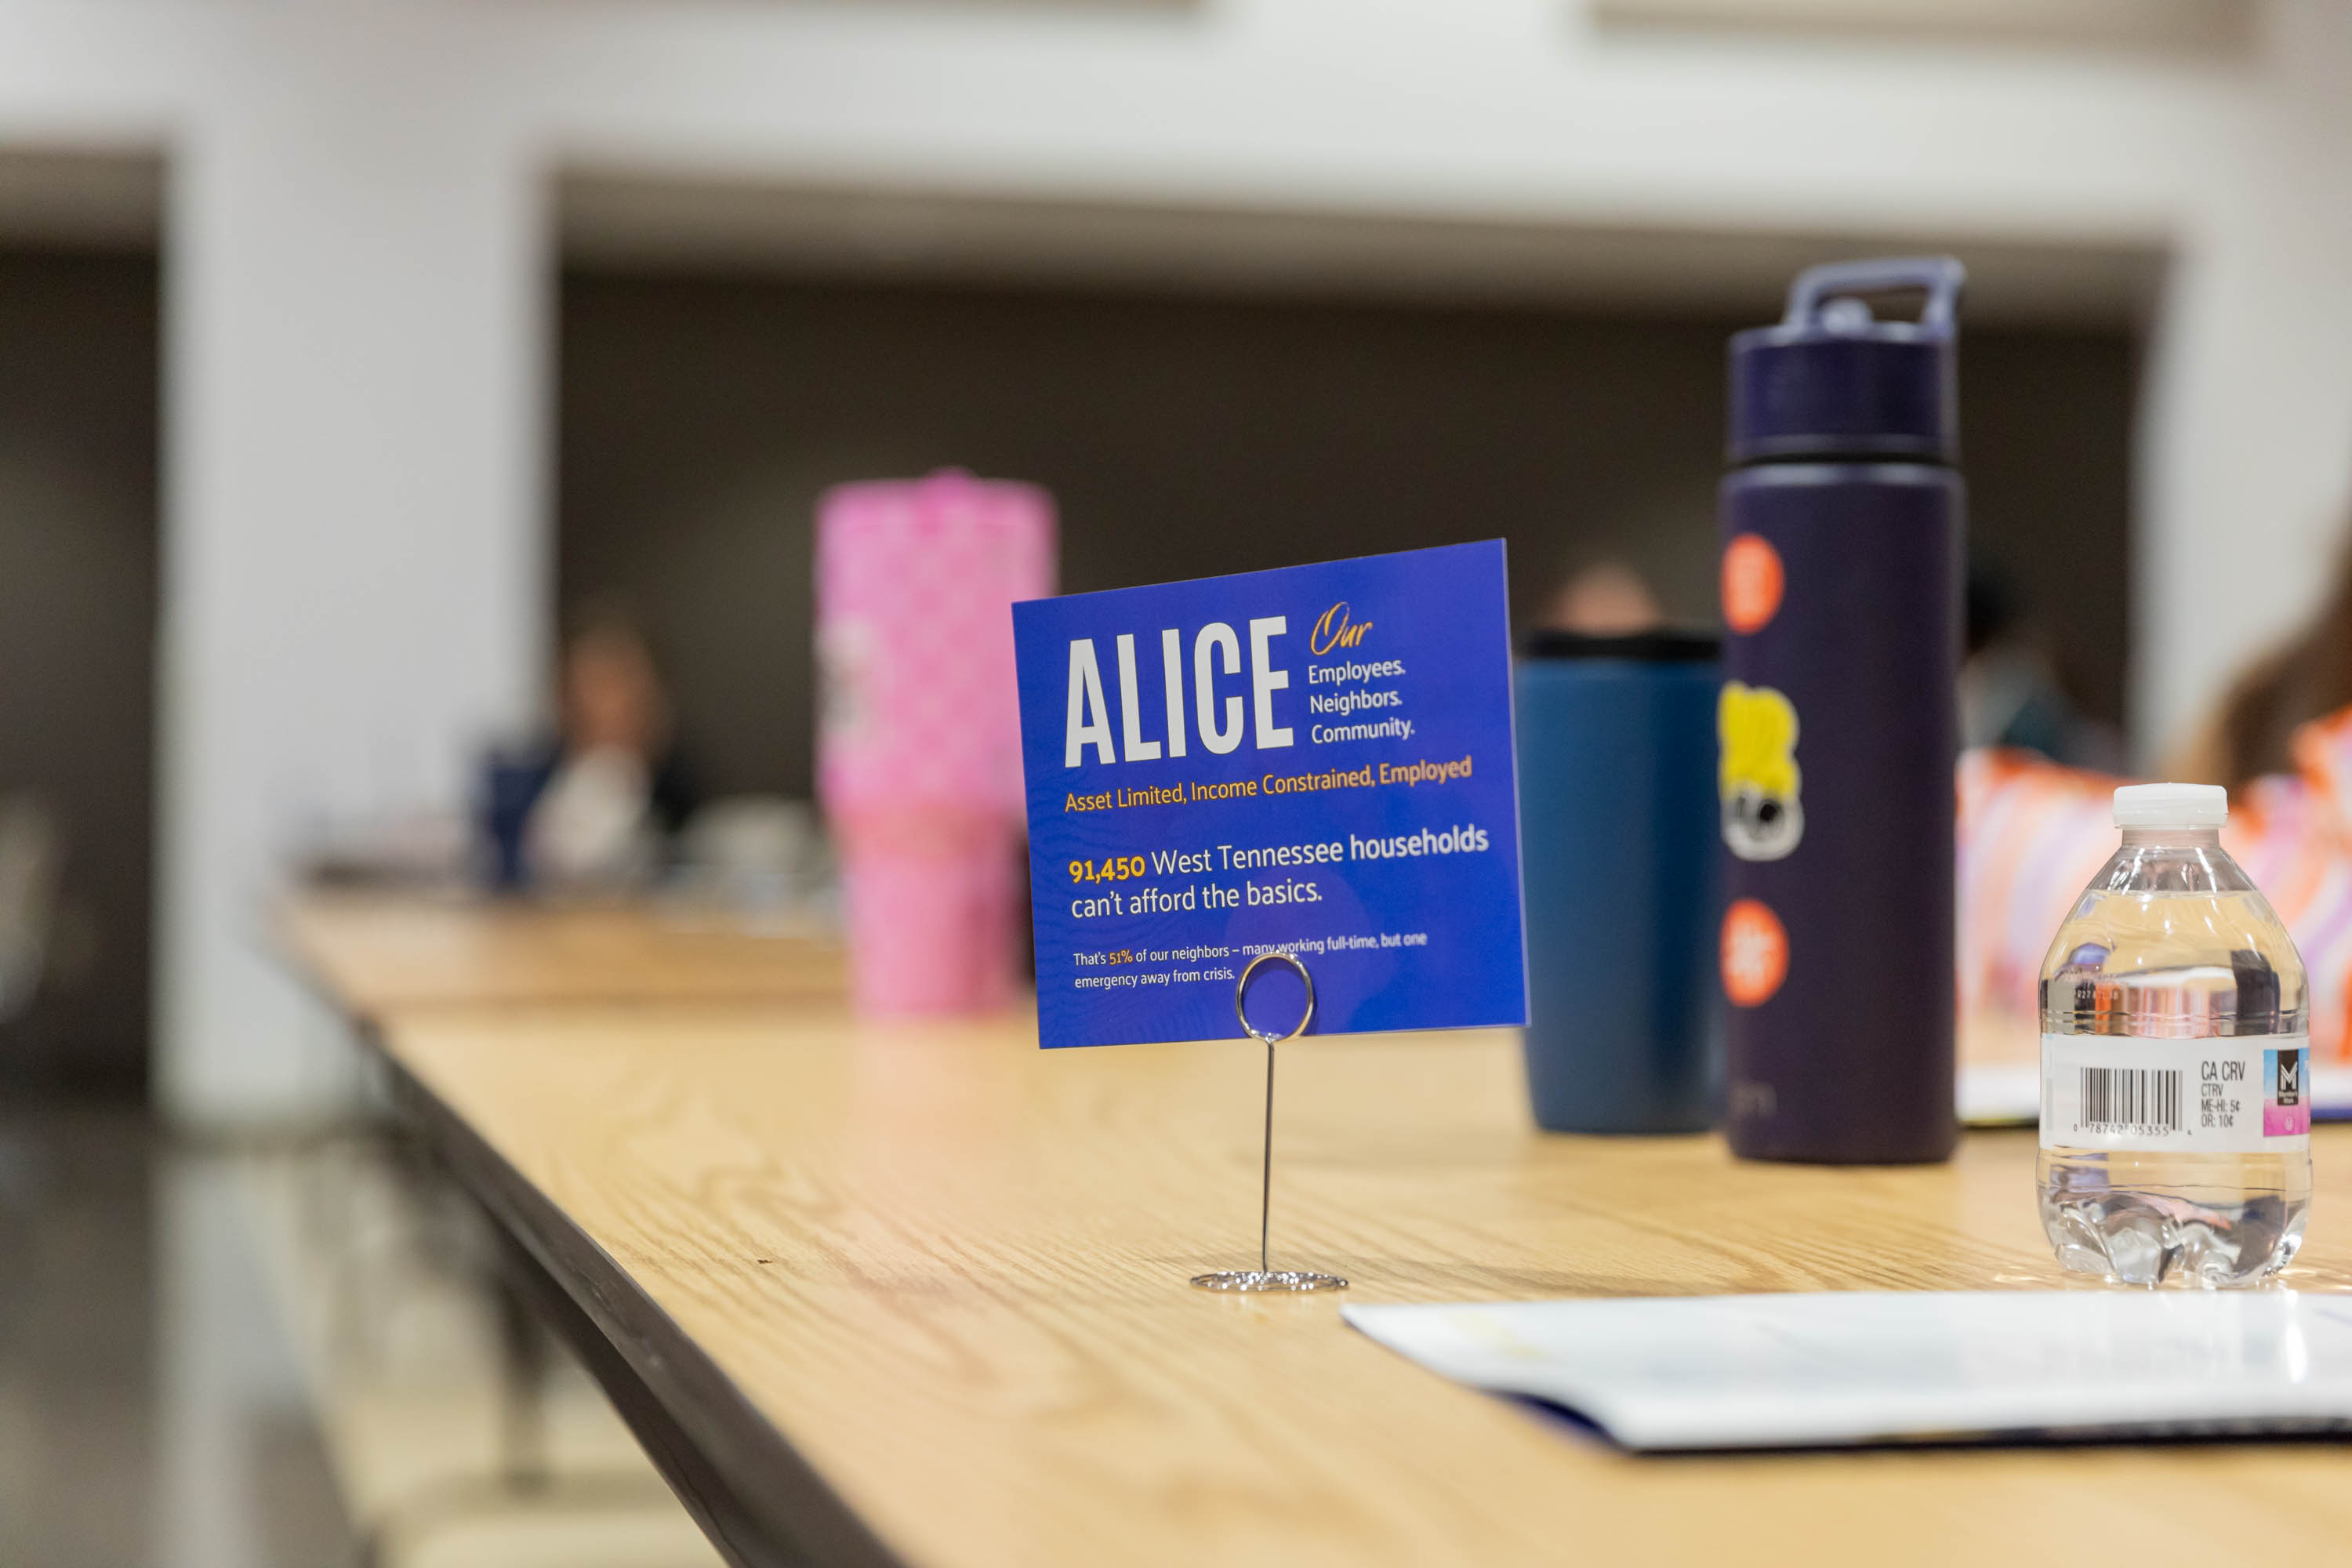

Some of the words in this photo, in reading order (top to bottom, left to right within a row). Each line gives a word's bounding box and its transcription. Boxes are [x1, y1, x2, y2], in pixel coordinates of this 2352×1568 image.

[1310, 602, 1373, 655] Our
[1308, 659, 1406, 686] Employees.
[1065, 616, 1294, 768] ALICE
[1310, 690, 1403, 716] Neighbors.
[1312, 717, 1415, 744] Community.
[1065, 792, 1112, 812] Asset
[1117, 786, 1187, 808] Limited,
[1191, 782, 1258, 801] Income
[1262, 765, 1376, 795] Constrained,
[1379, 755, 1472, 787] Employed
[1069, 856, 1145, 885] 91,450
[1151, 850, 1213, 875] West
[1217, 842, 1344, 870] Tennessee
[1350, 823, 1489, 860] households
[1071, 891, 1123, 919] can’t
[1130, 887, 1196, 914] afford
[1202, 884, 1240, 909] the
[1247, 878, 1323, 906] basics.
[1073, 951, 1107, 966] That’s
[1109, 949, 1134, 965] 51%
[1135, 949, 1147, 962] of
[1149, 951, 1169, 961] our
[1171, 945, 1230, 962] neighbors
[1276, 938, 1325, 956] working
[1327, 935, 1379, 951] full-time,
[1381, 933, 1401, 947] but
[1403, 933, 1428, 946] one
[1075, 975, 1138, 989] emergency
[1141, 972, 1171, 986] away
[1173, 969, 1200, 982] from
[1203, 967, 1236, 982] crisis.
[2201, 1061, 2218, 1081] CA
[2222, 1060, 2245, 1081] CRV
[2201, 1083, 2223, 1097] CTRV
[2201, 1113, 2216, 1127] OR:
